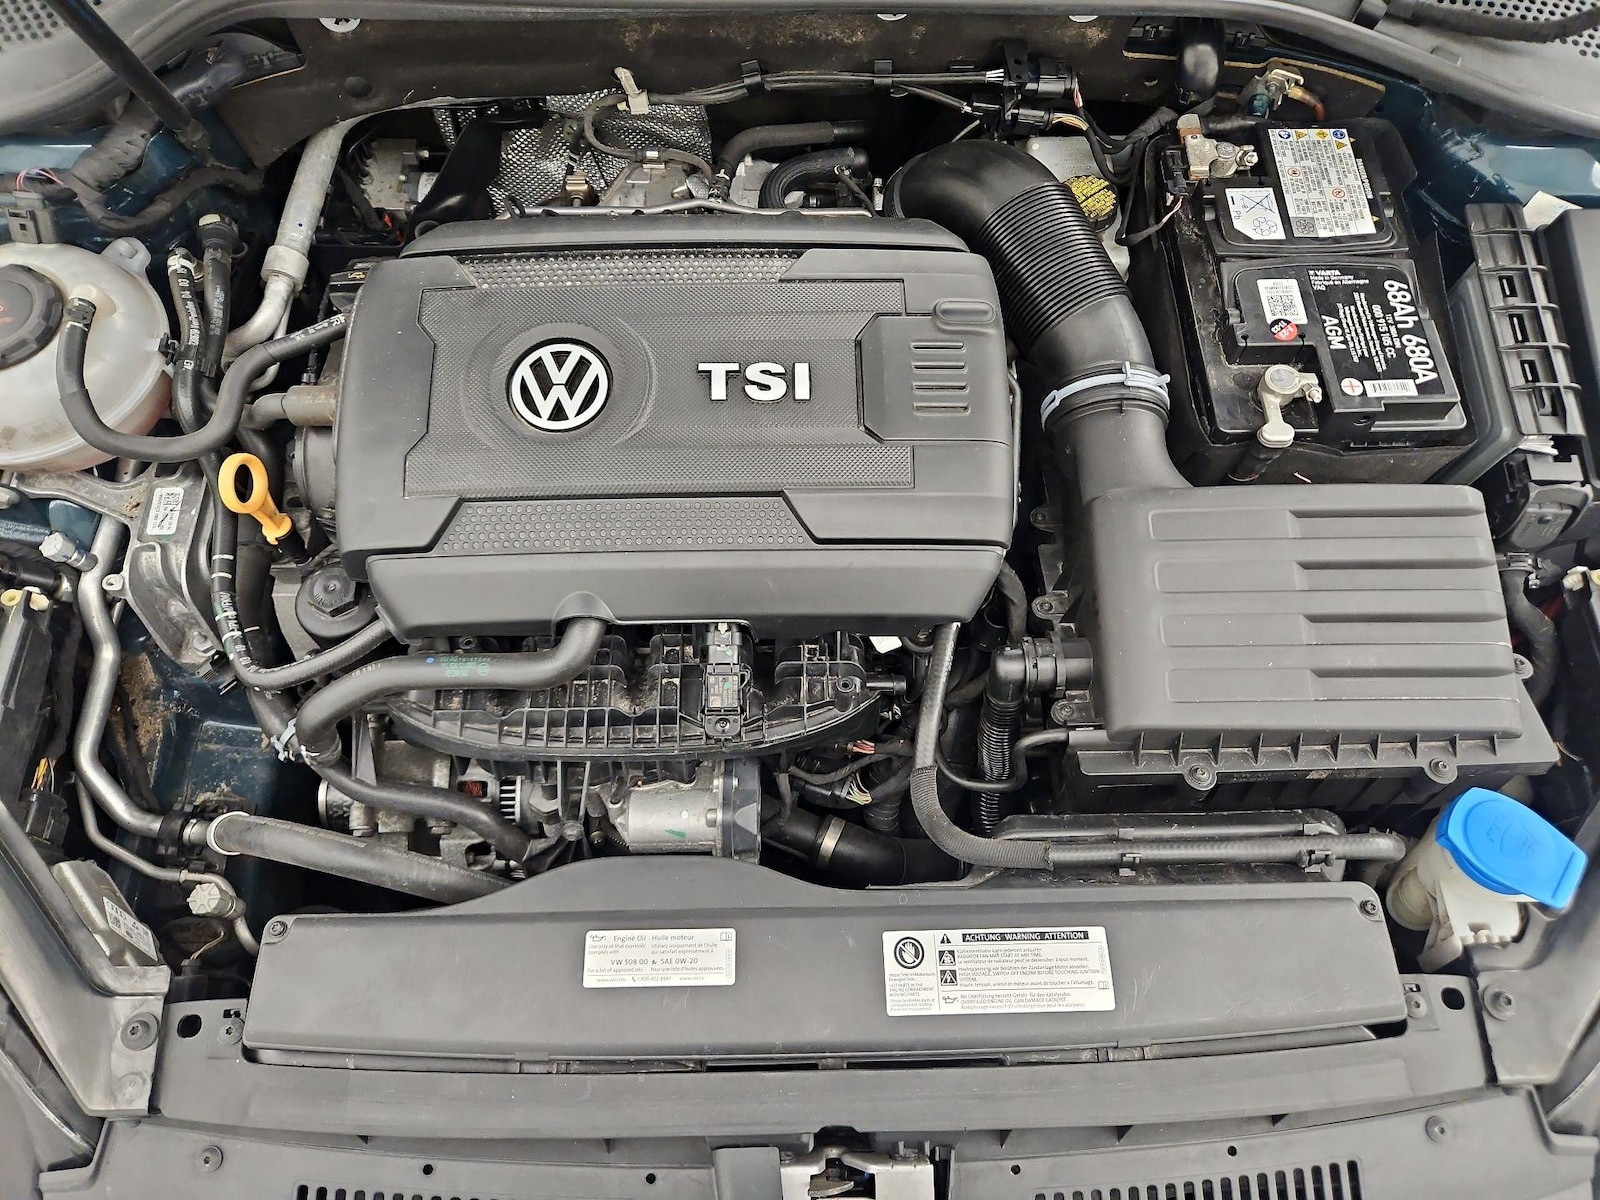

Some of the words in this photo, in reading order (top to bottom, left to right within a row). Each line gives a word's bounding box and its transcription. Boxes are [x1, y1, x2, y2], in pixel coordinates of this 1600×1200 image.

[1233, 210, 1242, 220] Pb
[1372, 304, 1384, 318] 000
[1384, 280, 1419, 329] 68Ah
[1377, 318, 1388, 332] 915
[1321, 315, 1346, 350] AGM
[1381, 333, 1392, 346] 105
[1386, 347, 1396, 358] CC
[1401, 334, 1438, 384] 680A
[698, 362, 811, 402] TSI
[614, 935, 636, 943] Engine
[1044, 932, 1084, 940] ATTENTION
